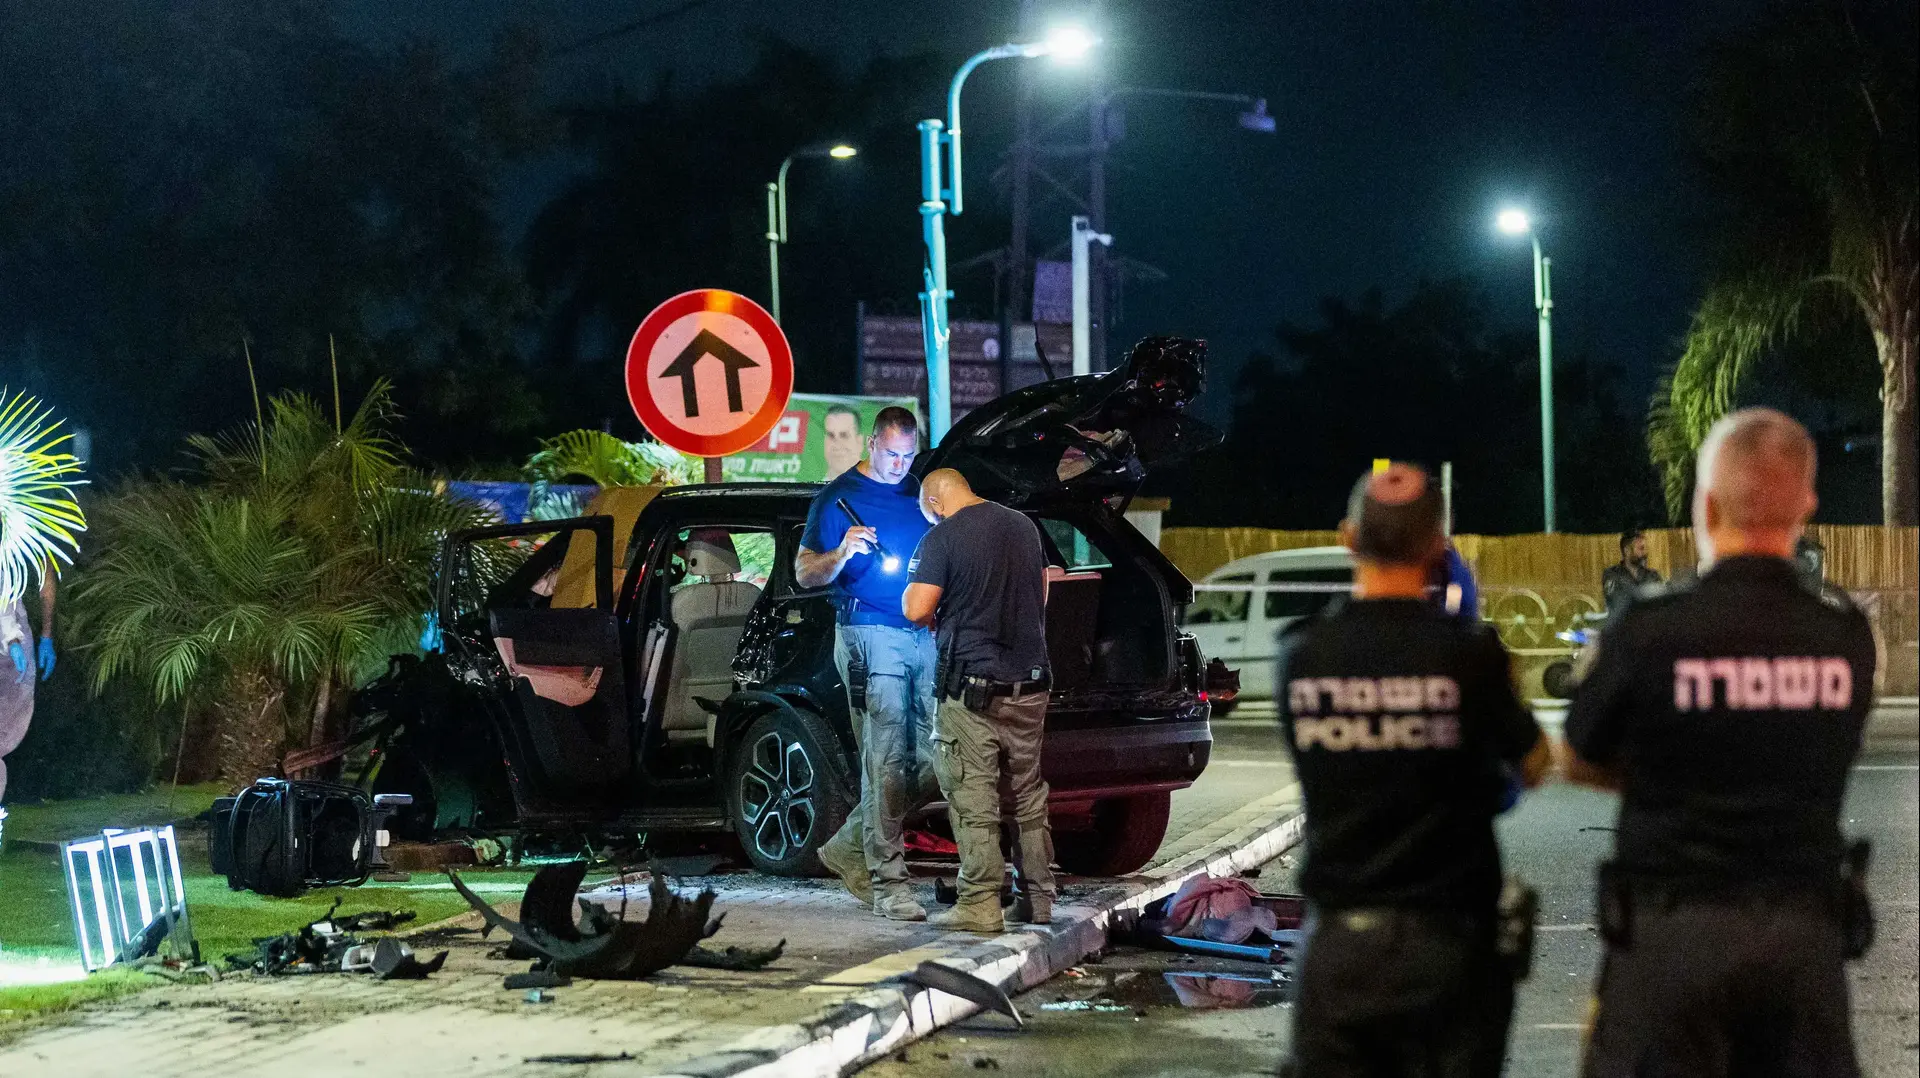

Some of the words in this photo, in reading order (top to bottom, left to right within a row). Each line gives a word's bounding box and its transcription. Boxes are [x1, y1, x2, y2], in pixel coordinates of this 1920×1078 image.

[1288, 675, 1462, 711] משטרה
[1673, 657, 1853, 711] משטרה
[1295, 712, 1462, 752] POLICE
